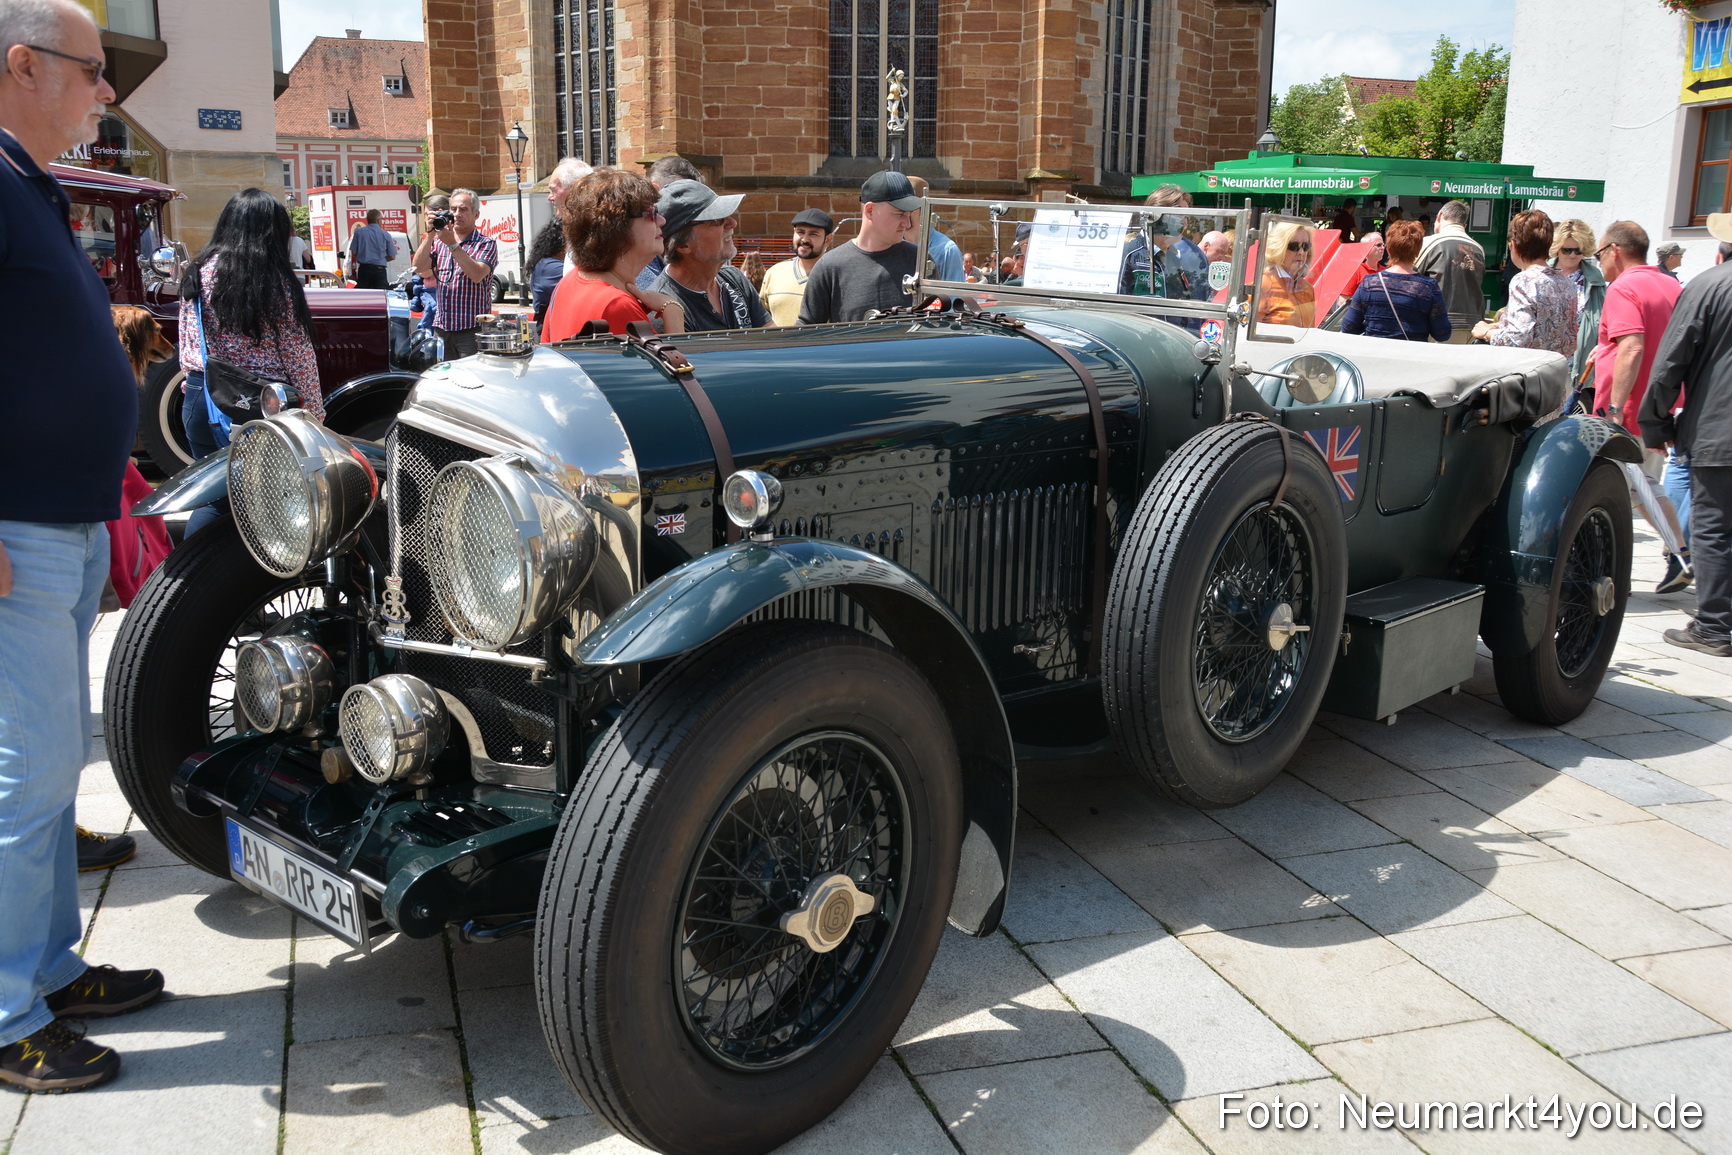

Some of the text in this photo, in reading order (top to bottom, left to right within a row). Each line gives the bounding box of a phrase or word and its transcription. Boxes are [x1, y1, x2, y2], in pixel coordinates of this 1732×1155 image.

[1691, 17, 1732, 72] W
[93, 146, 152, 157] Erlebnishaus.
[1221, 176, 1354, 189] Neumarkter Lammsbräu
[1444, 182, 1564, 197] Neumarkter Lammsbräu
[500, 232, 519, 241] IMBISS
[1077, 222, 1109, 240] 558
[234, 852, 241, 865] D
[243, 835, 357, 934] AN RR 2H
